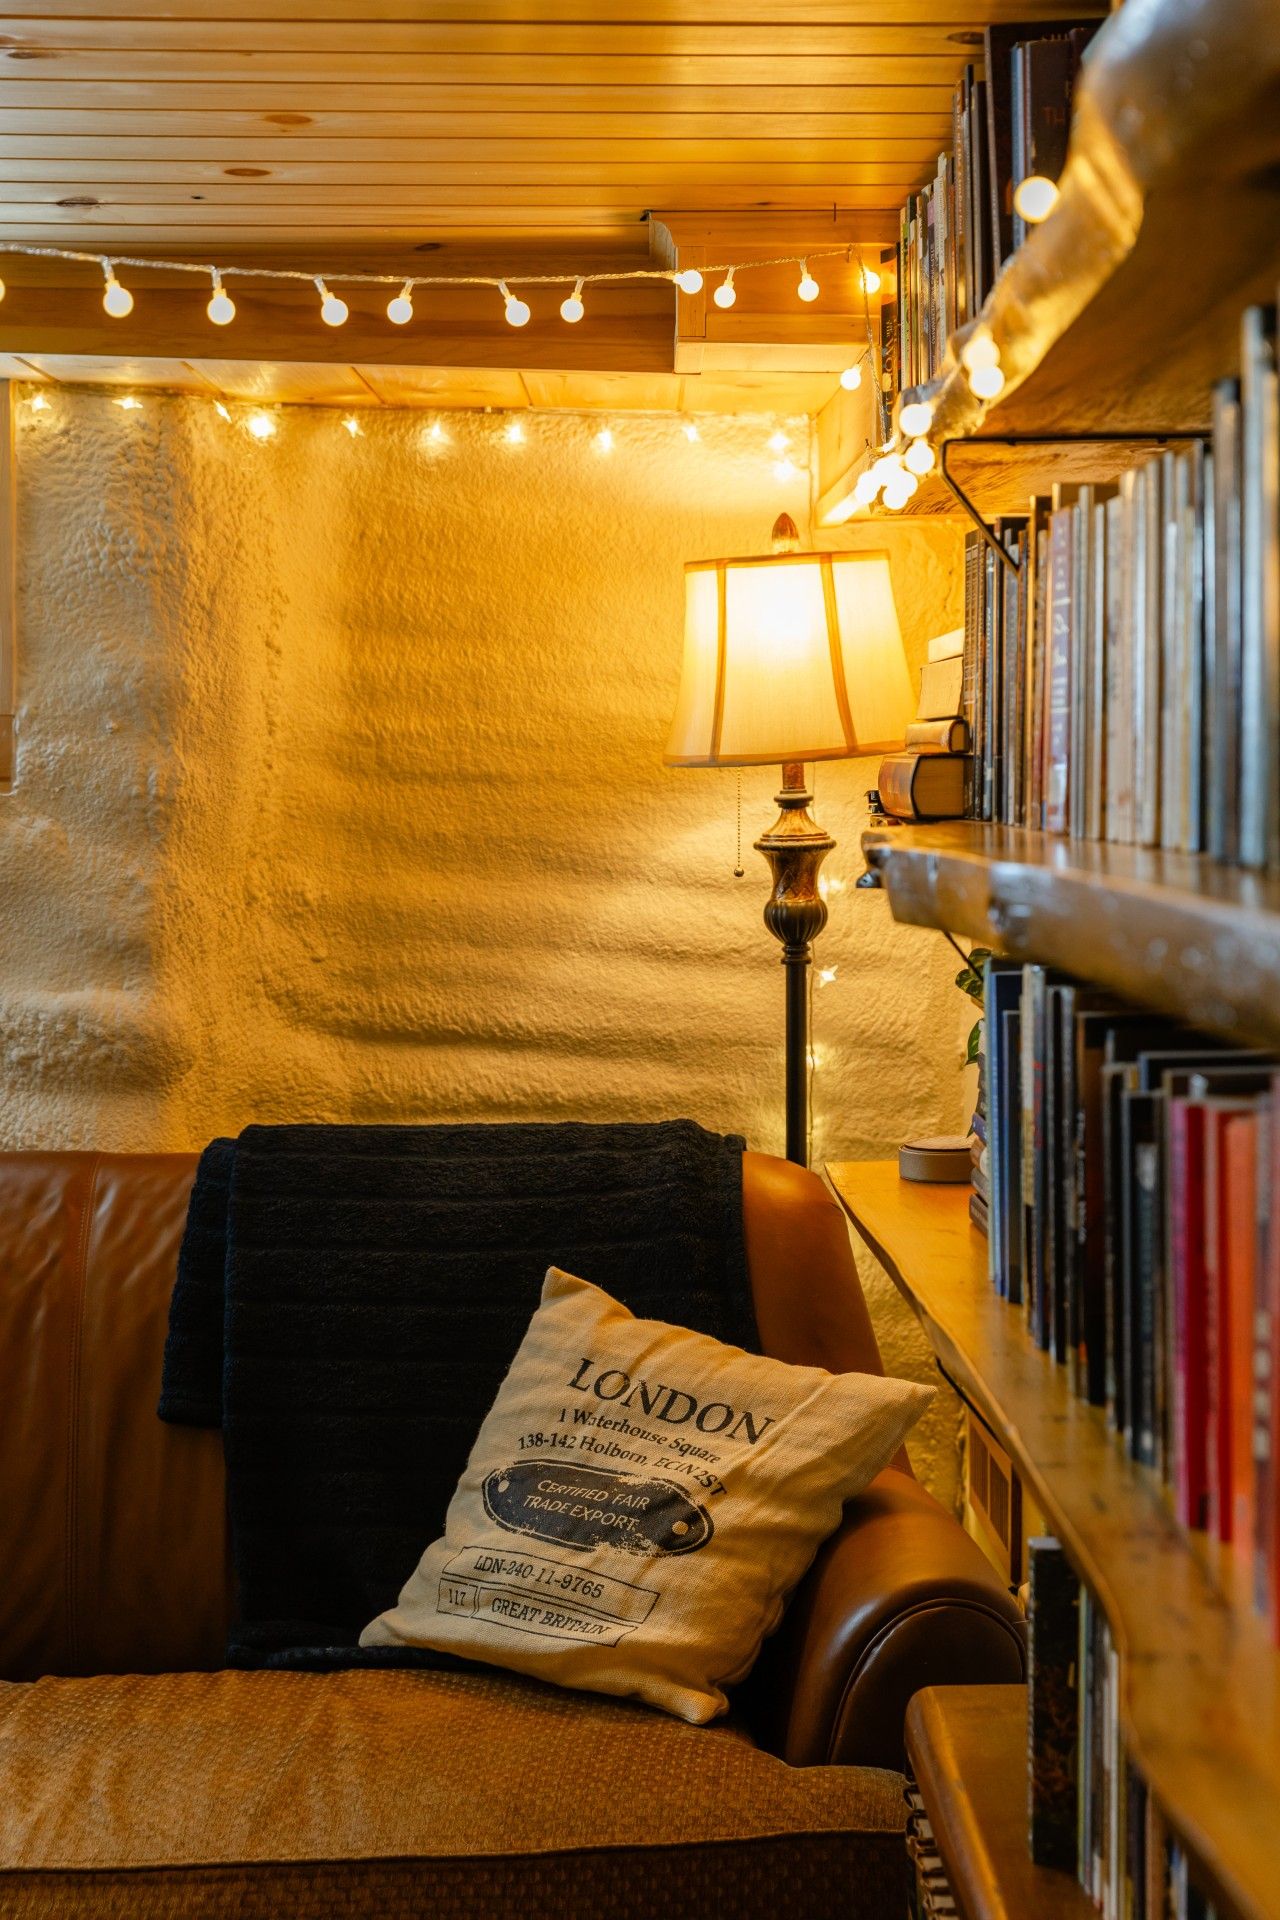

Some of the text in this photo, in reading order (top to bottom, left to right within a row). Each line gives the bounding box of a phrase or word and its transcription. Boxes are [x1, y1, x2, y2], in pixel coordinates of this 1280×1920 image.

[567, 1357, 776, 1445] LONDON
[518, 1432, 577, 1450] 138-142
[579, 1435, 648, 1467] Holborn,
[559, 1408, 721, 1464] 1 Waterhouse Square
[523, 1495, 571, 1514] TRADE
[537, 1480, 650, 1510] CERTIFIED FAIR
[473, 1555, 605, 1599] LDN-240-11-9765
[491, 1597, 612, 1635] GREAT BRITAIN
